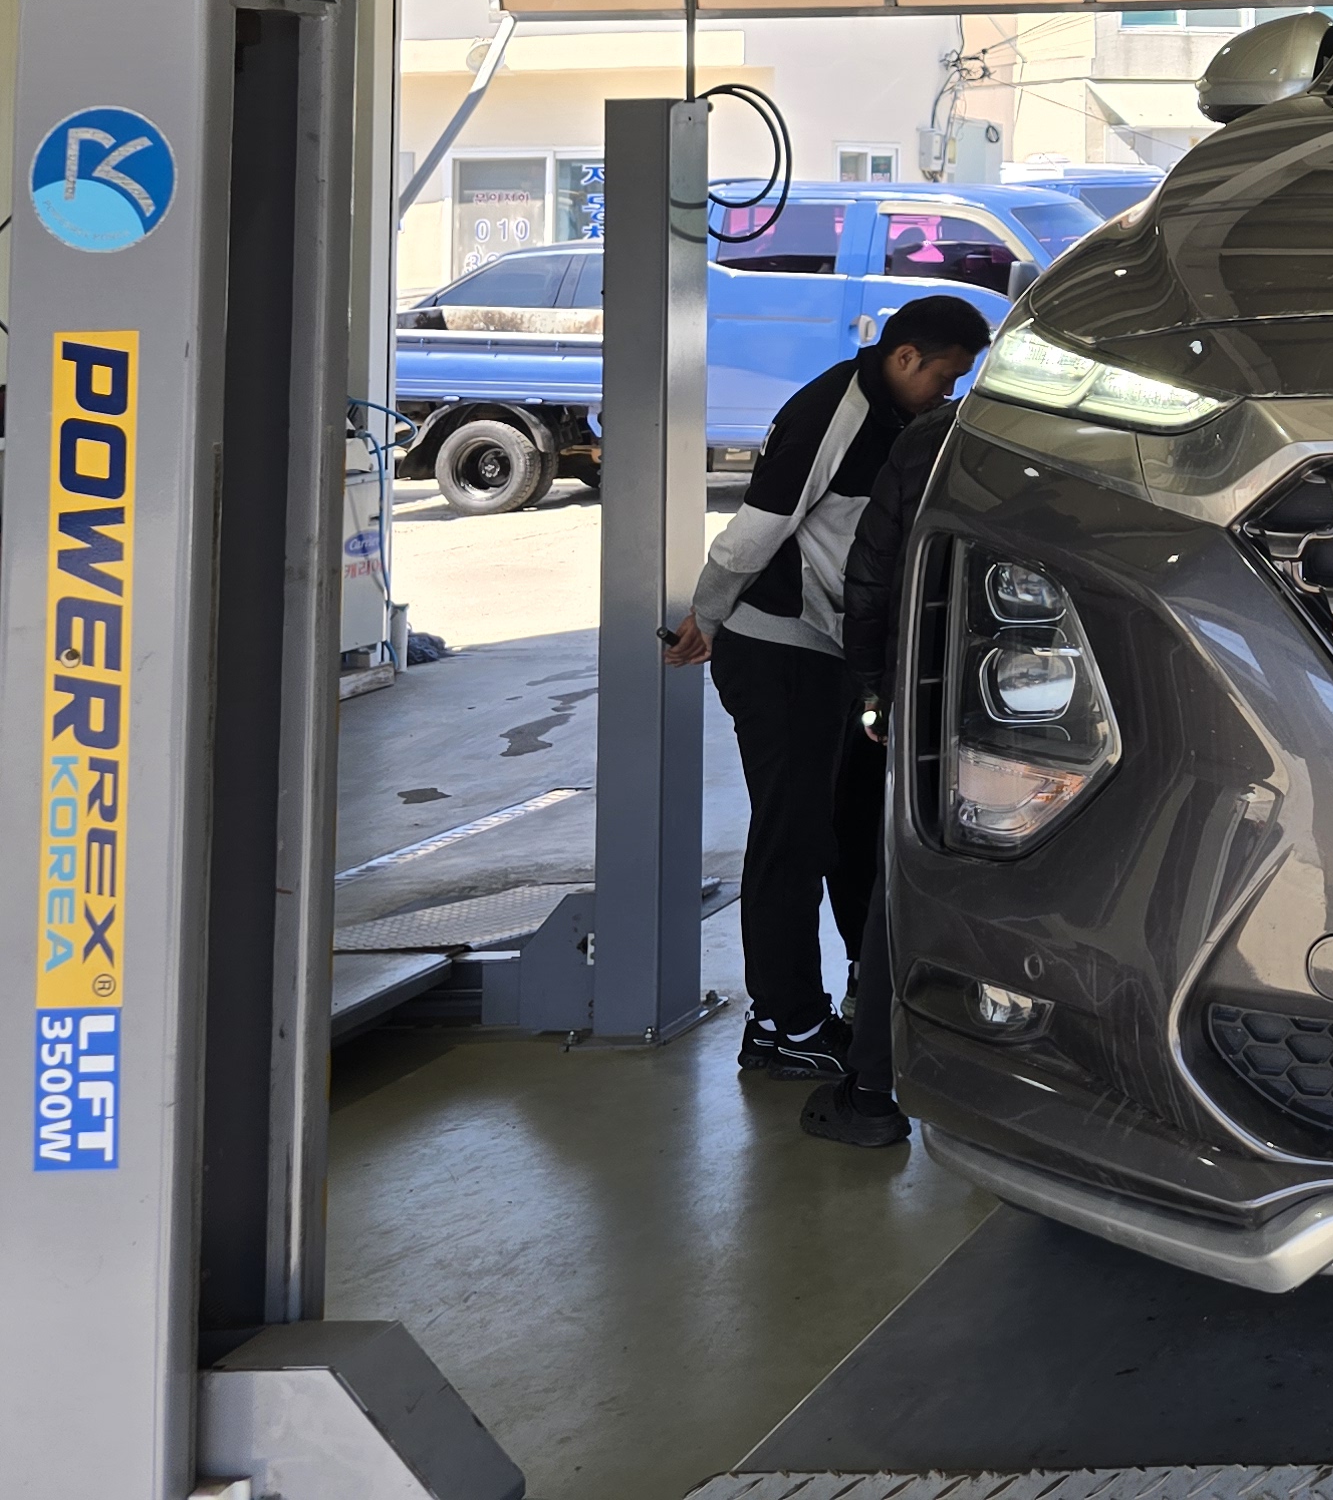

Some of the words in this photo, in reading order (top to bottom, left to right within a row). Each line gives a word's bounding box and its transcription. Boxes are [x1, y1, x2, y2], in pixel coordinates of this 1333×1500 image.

[45, 755, 80, 972] KOREA
[40, 1016, 73, 1163] 3500W
[78, 1014, 116, 1163] LIFT
